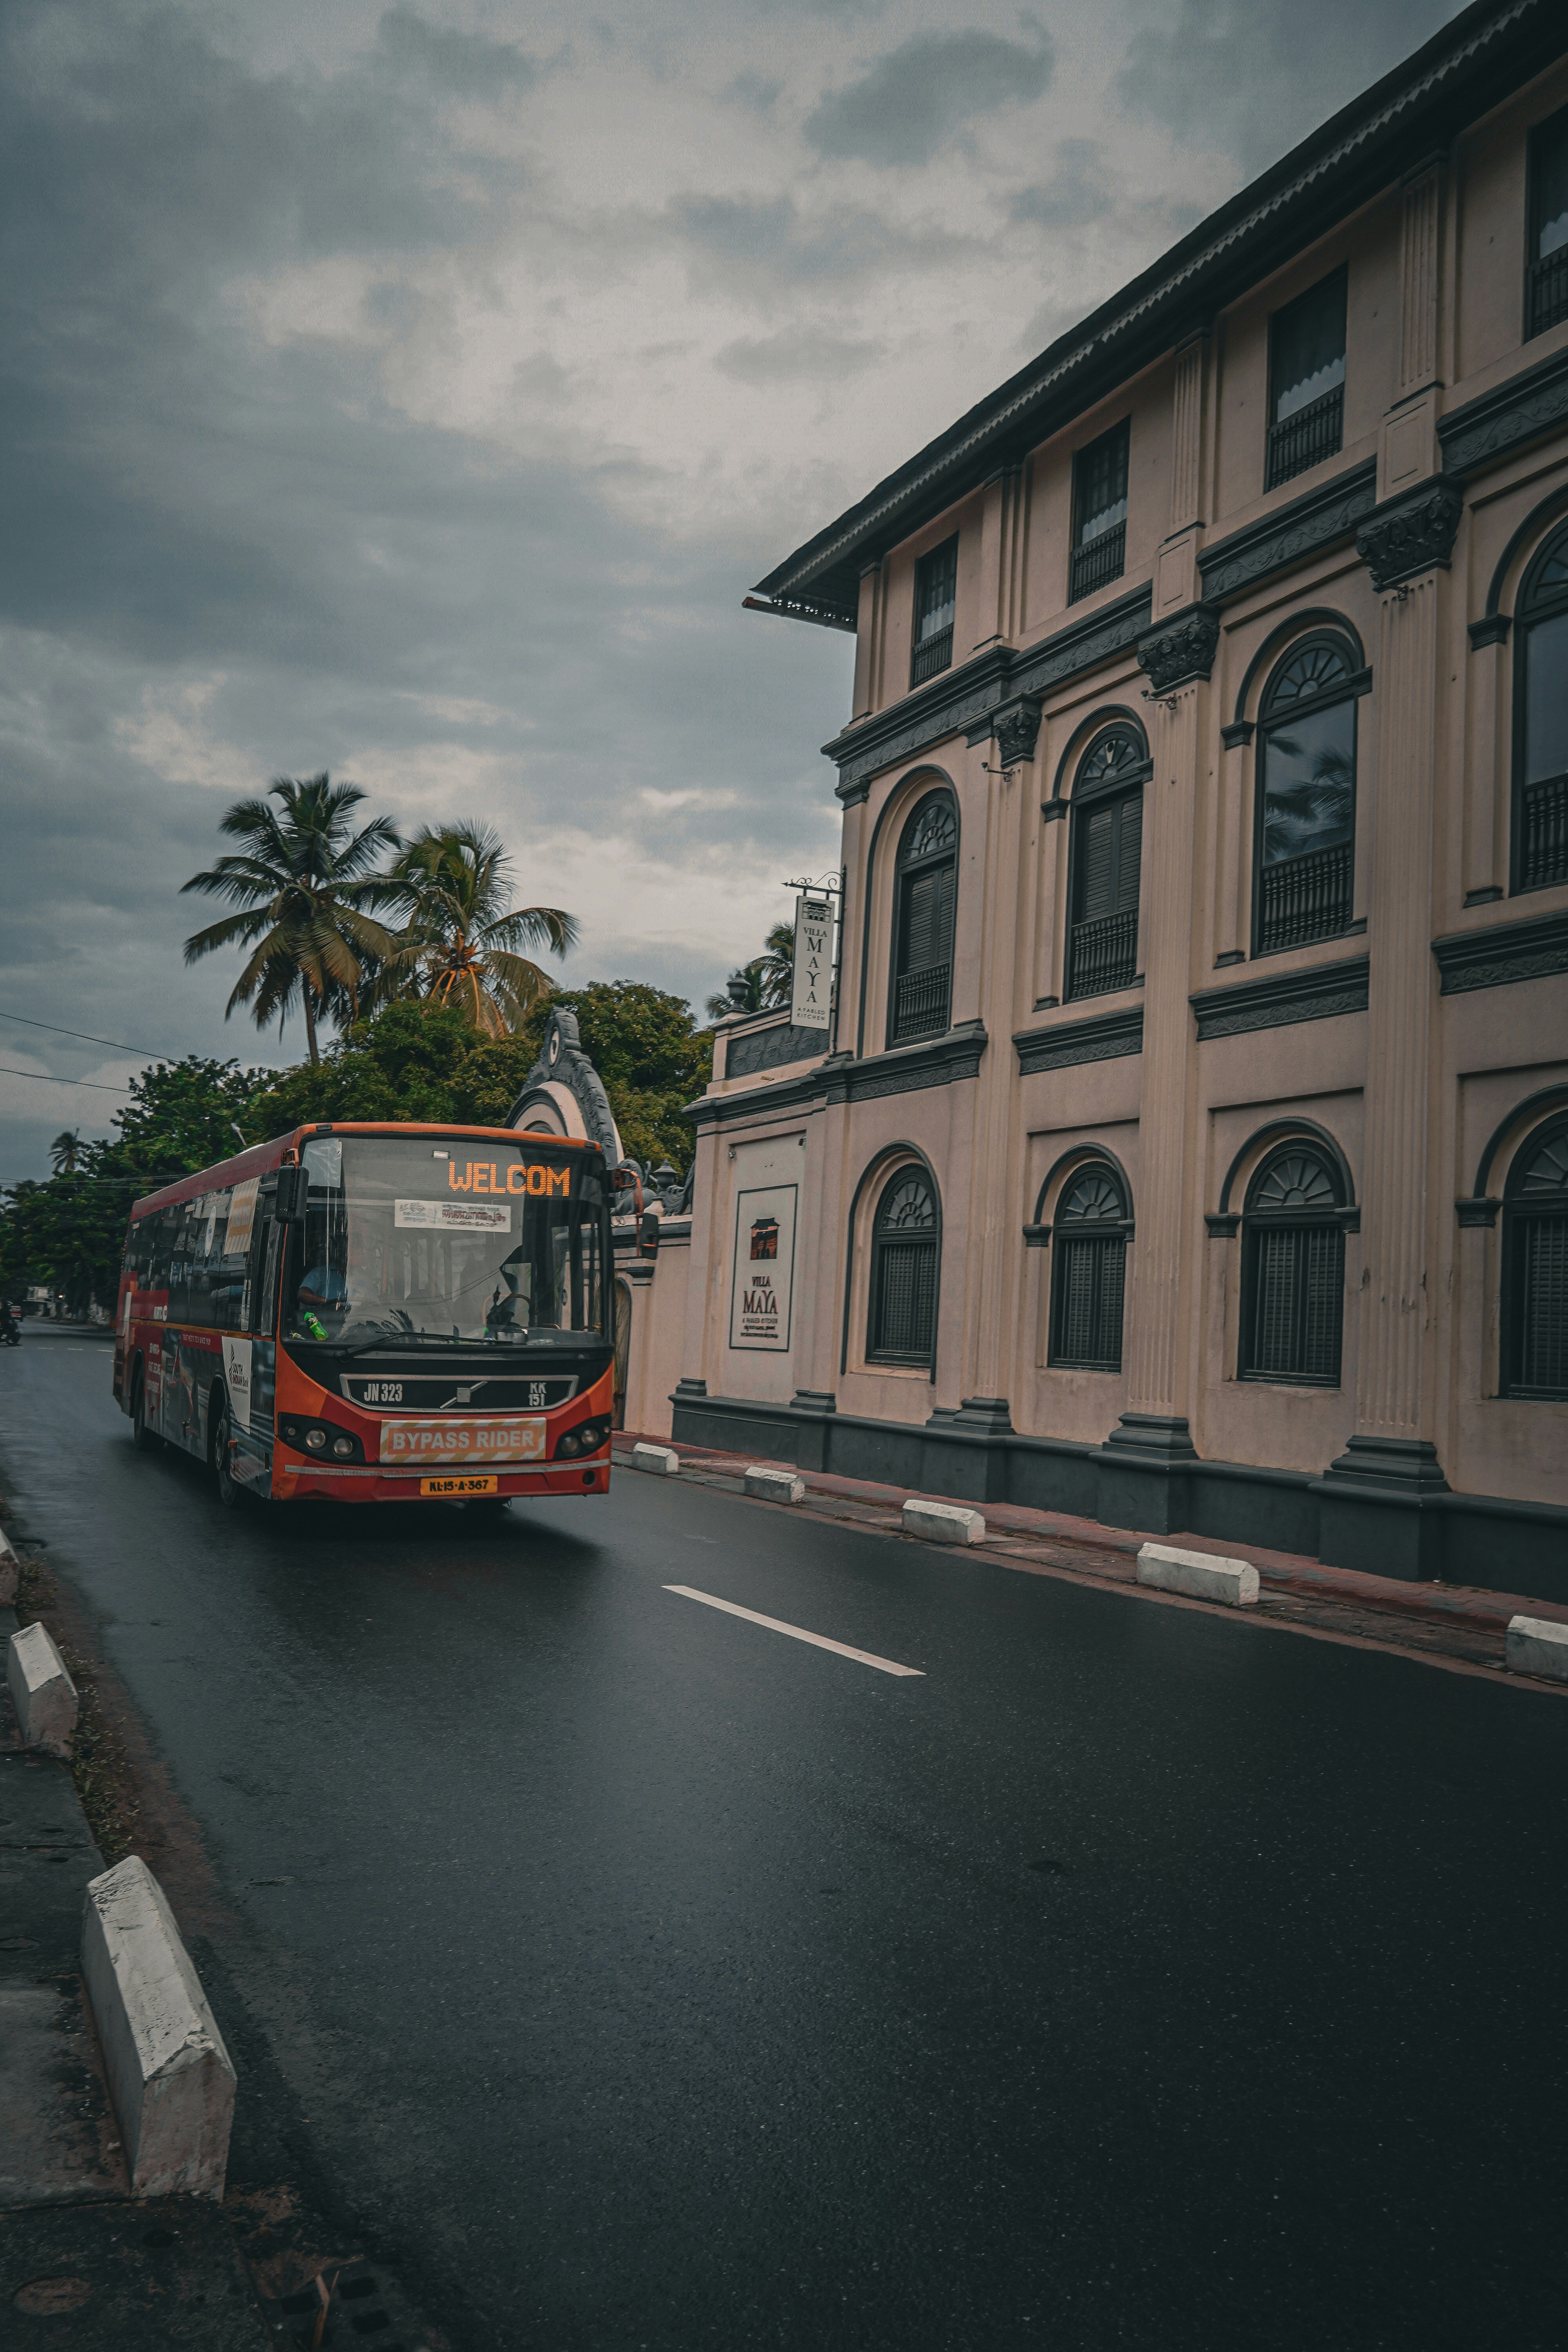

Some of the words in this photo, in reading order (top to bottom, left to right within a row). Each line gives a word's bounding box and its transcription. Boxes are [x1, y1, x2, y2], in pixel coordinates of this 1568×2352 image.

[803, 927, 828, 937] VILLA
[805, 936, 824, 1003] MAYA
[448, 1161, 570, 1196] WELCOM
[752, 1276, 771, 1287] VILLA
[742, 1290, 779, 1314] MAYA
[233, 1362, 243, 1375] SOUTH
[232, 1374, 243, 1387] INDIAN
[364, 1383, 379, 1401] JN
[381, 1383, 403, 1402] 323
[530, 1382, 547, 1394] KK
[528, 1393, 545, 1406] 151
[393, 1432, 470, 1450] BYPASS
[476, 1430, 534, 1448] RIDER
